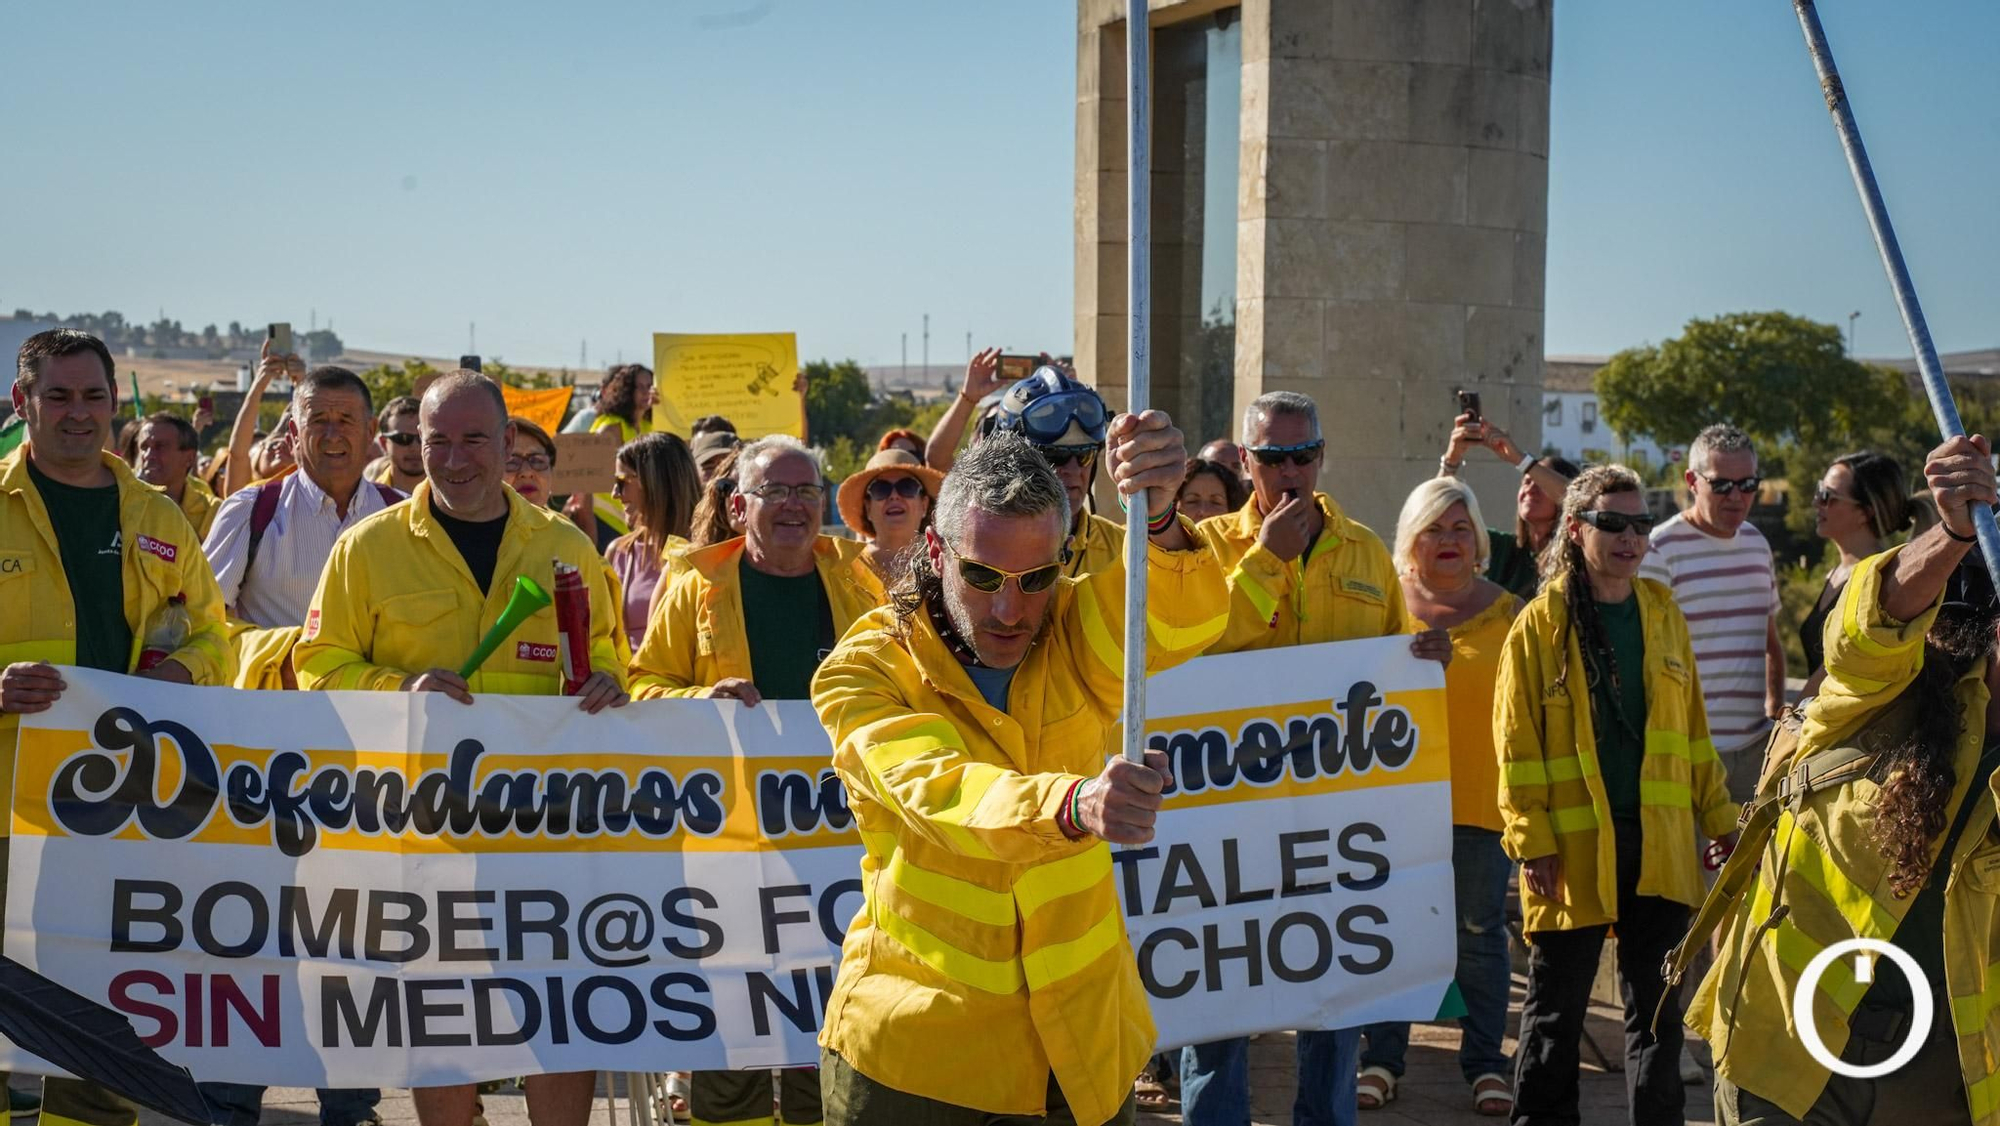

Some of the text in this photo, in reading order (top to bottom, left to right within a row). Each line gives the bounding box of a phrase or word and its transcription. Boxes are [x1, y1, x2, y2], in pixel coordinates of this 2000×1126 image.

[52, 680, 1415, 857] Defendamos nu monte
[110, 822, 1391, 968] BOMBER@S FO TALES
[108, 969, 282, 1048] SIN
[321, 971, 717, 1048] MEDIOS
[1136, 904, 1394, 1000] CHOS
